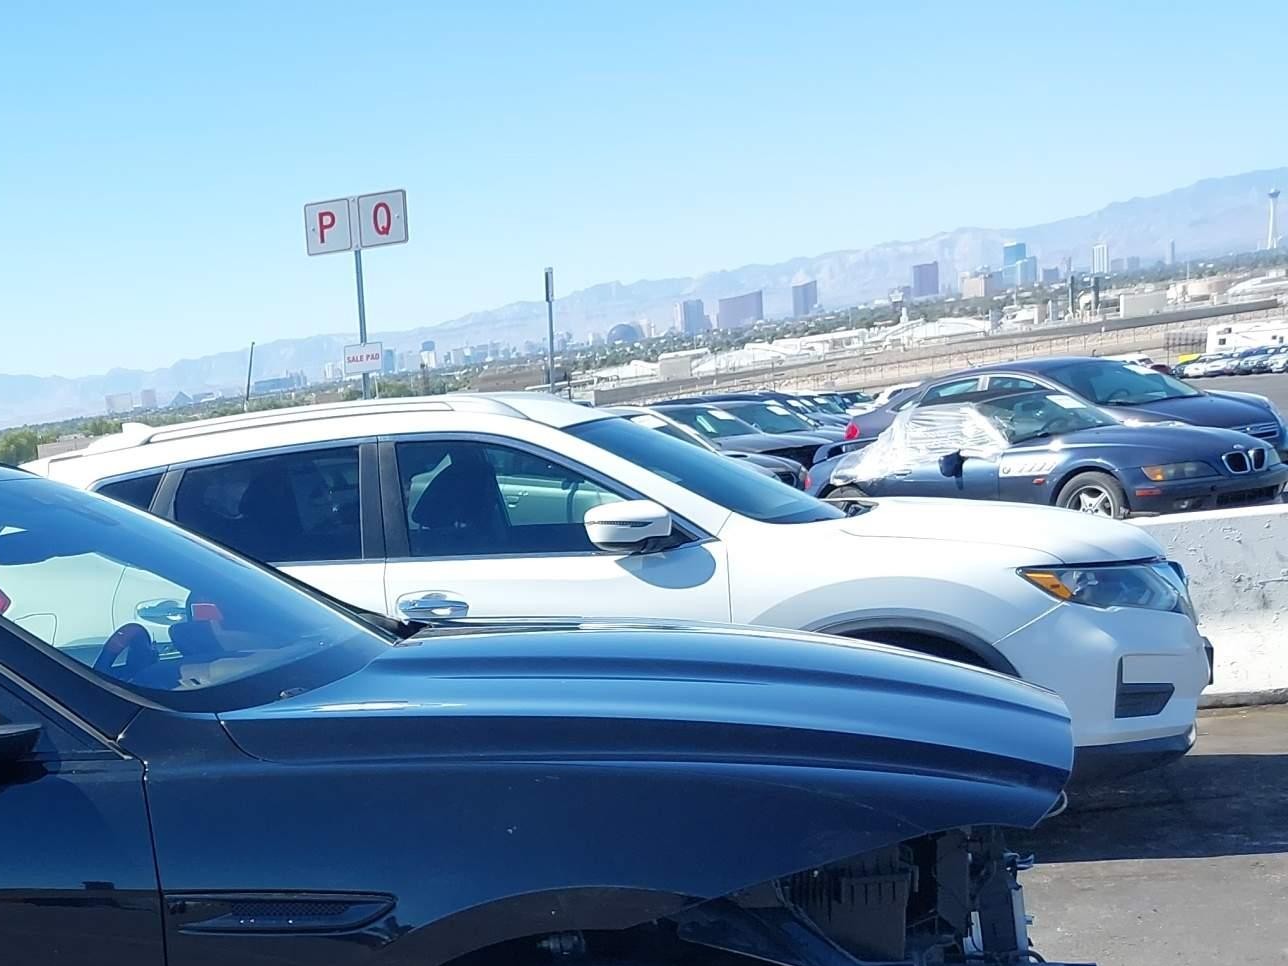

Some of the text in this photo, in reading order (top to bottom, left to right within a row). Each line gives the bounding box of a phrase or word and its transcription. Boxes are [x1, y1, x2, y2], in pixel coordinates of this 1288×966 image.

[318, 211, 336, 244] P
[373, 202, 392, 236] Q
[346, 354, 364, 363] SALE
